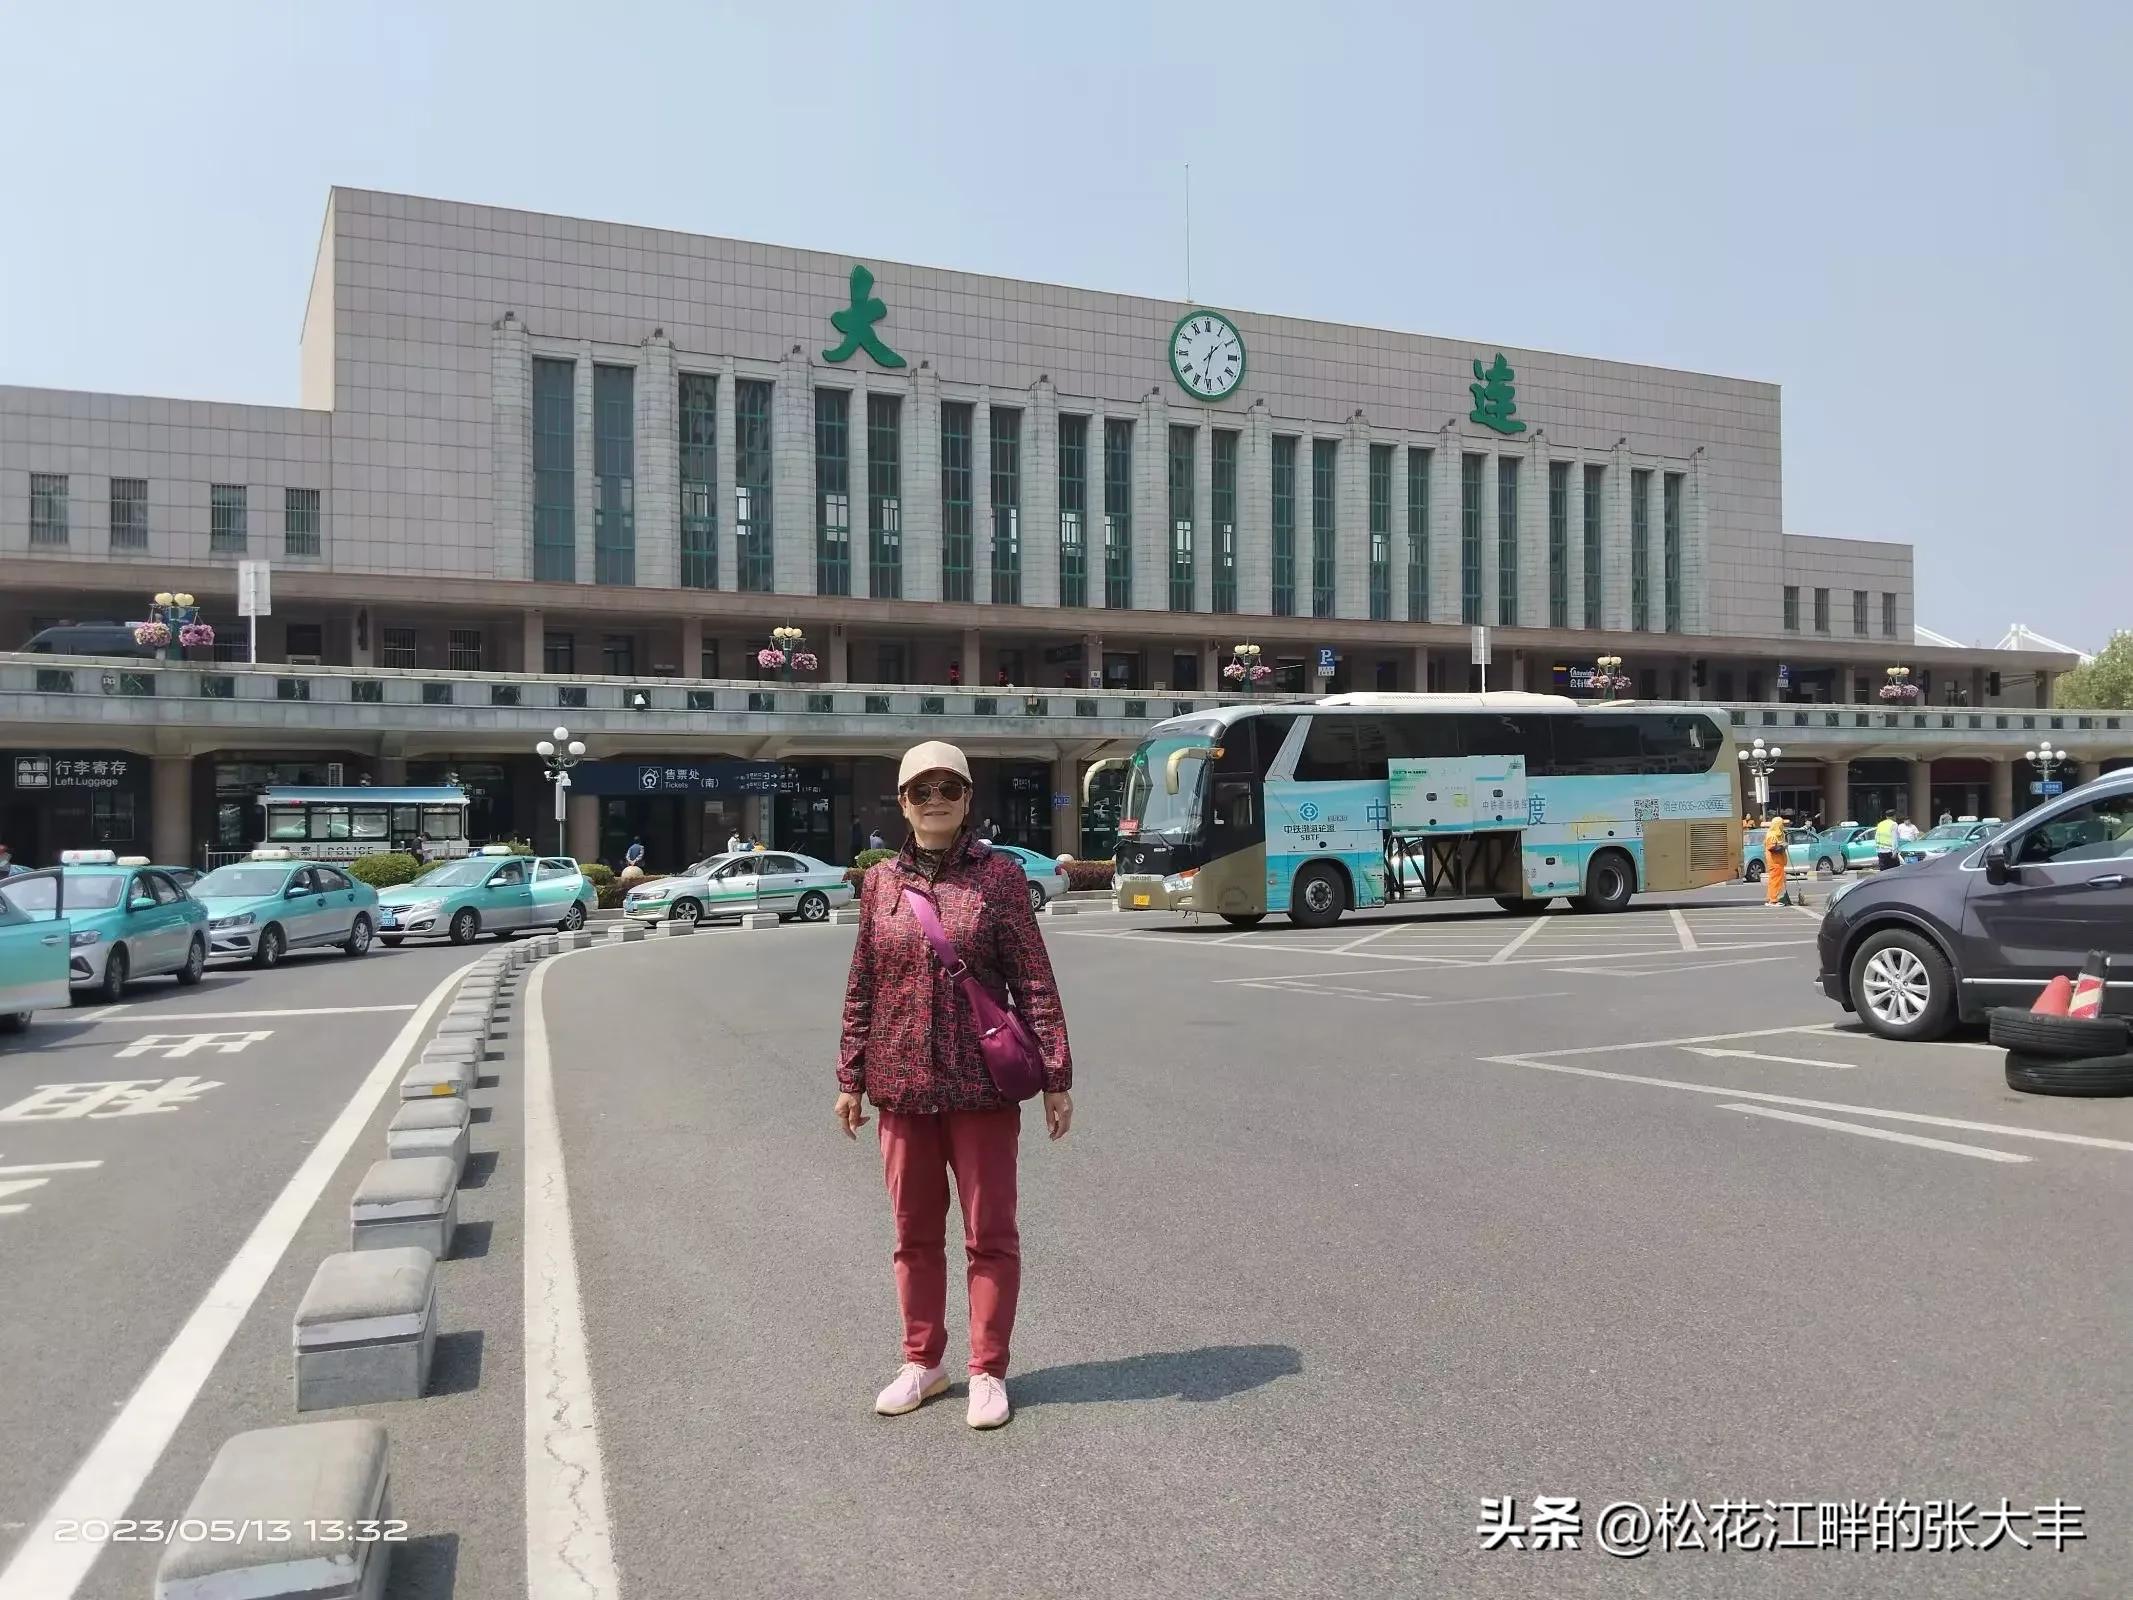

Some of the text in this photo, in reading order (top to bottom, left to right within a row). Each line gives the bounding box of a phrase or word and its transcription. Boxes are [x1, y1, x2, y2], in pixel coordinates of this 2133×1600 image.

[822, 265, 1527, 435] 大 连
[55, 760, 127, 776] 行李寄存
[665, 768, 700, 780] 售票处
[55, 778, 119, 788] Left Luggage
[665, 781, 689, 789] Tickets
[1300, 833, 1320, 841] SBTF
[327, 846, 374, 856] POLICE
